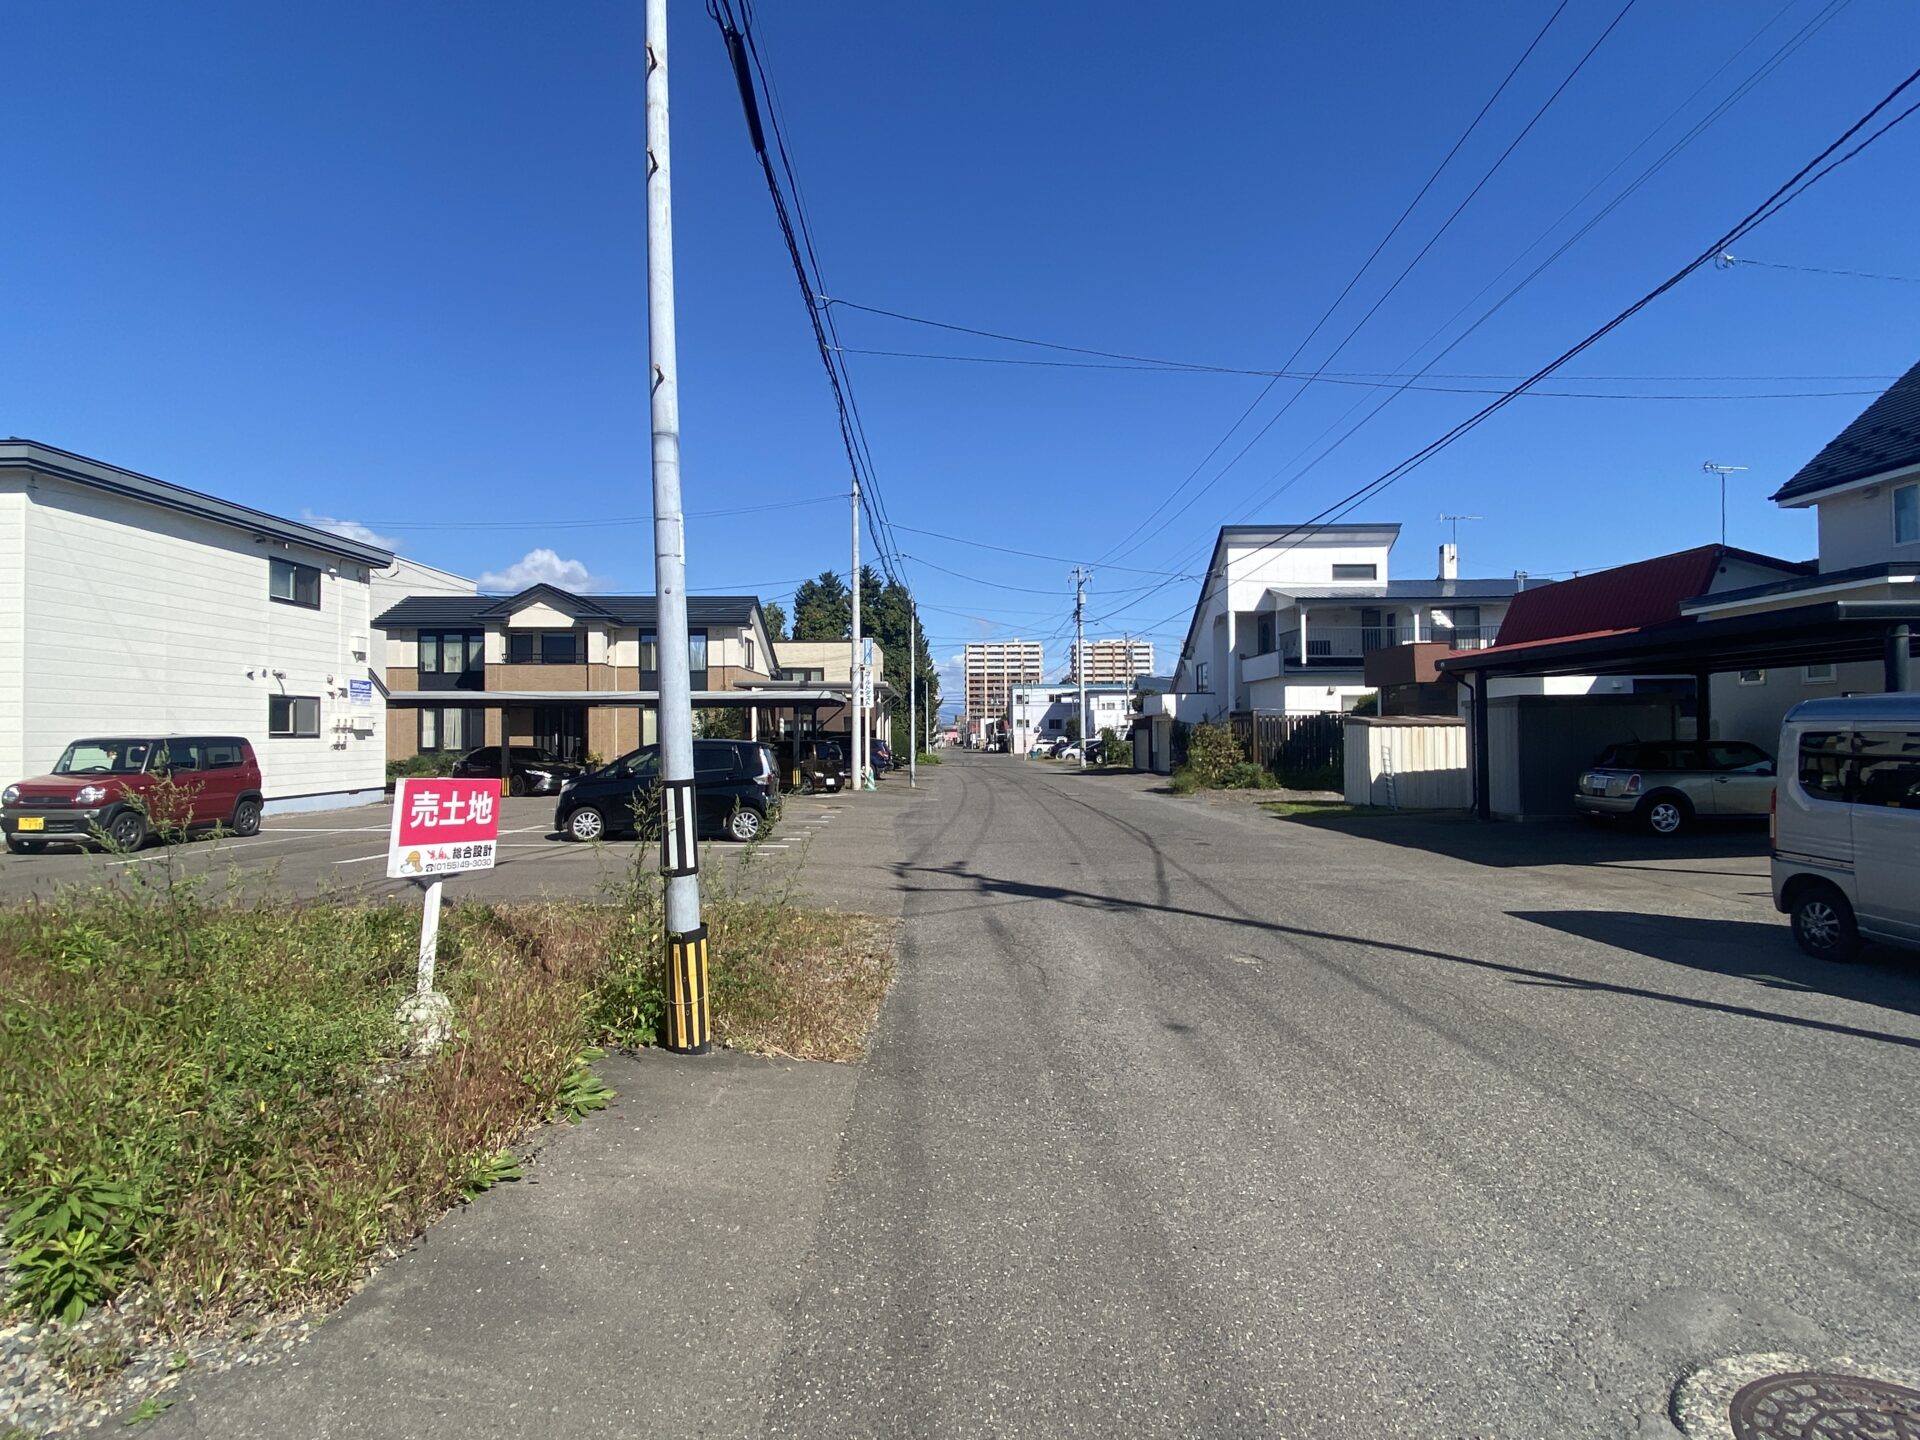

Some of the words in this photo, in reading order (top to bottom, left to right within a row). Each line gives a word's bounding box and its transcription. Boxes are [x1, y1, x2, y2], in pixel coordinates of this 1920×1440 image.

[410, 790, 493, 828] 売土地
[452, 844, 492, 859] 総合設計
